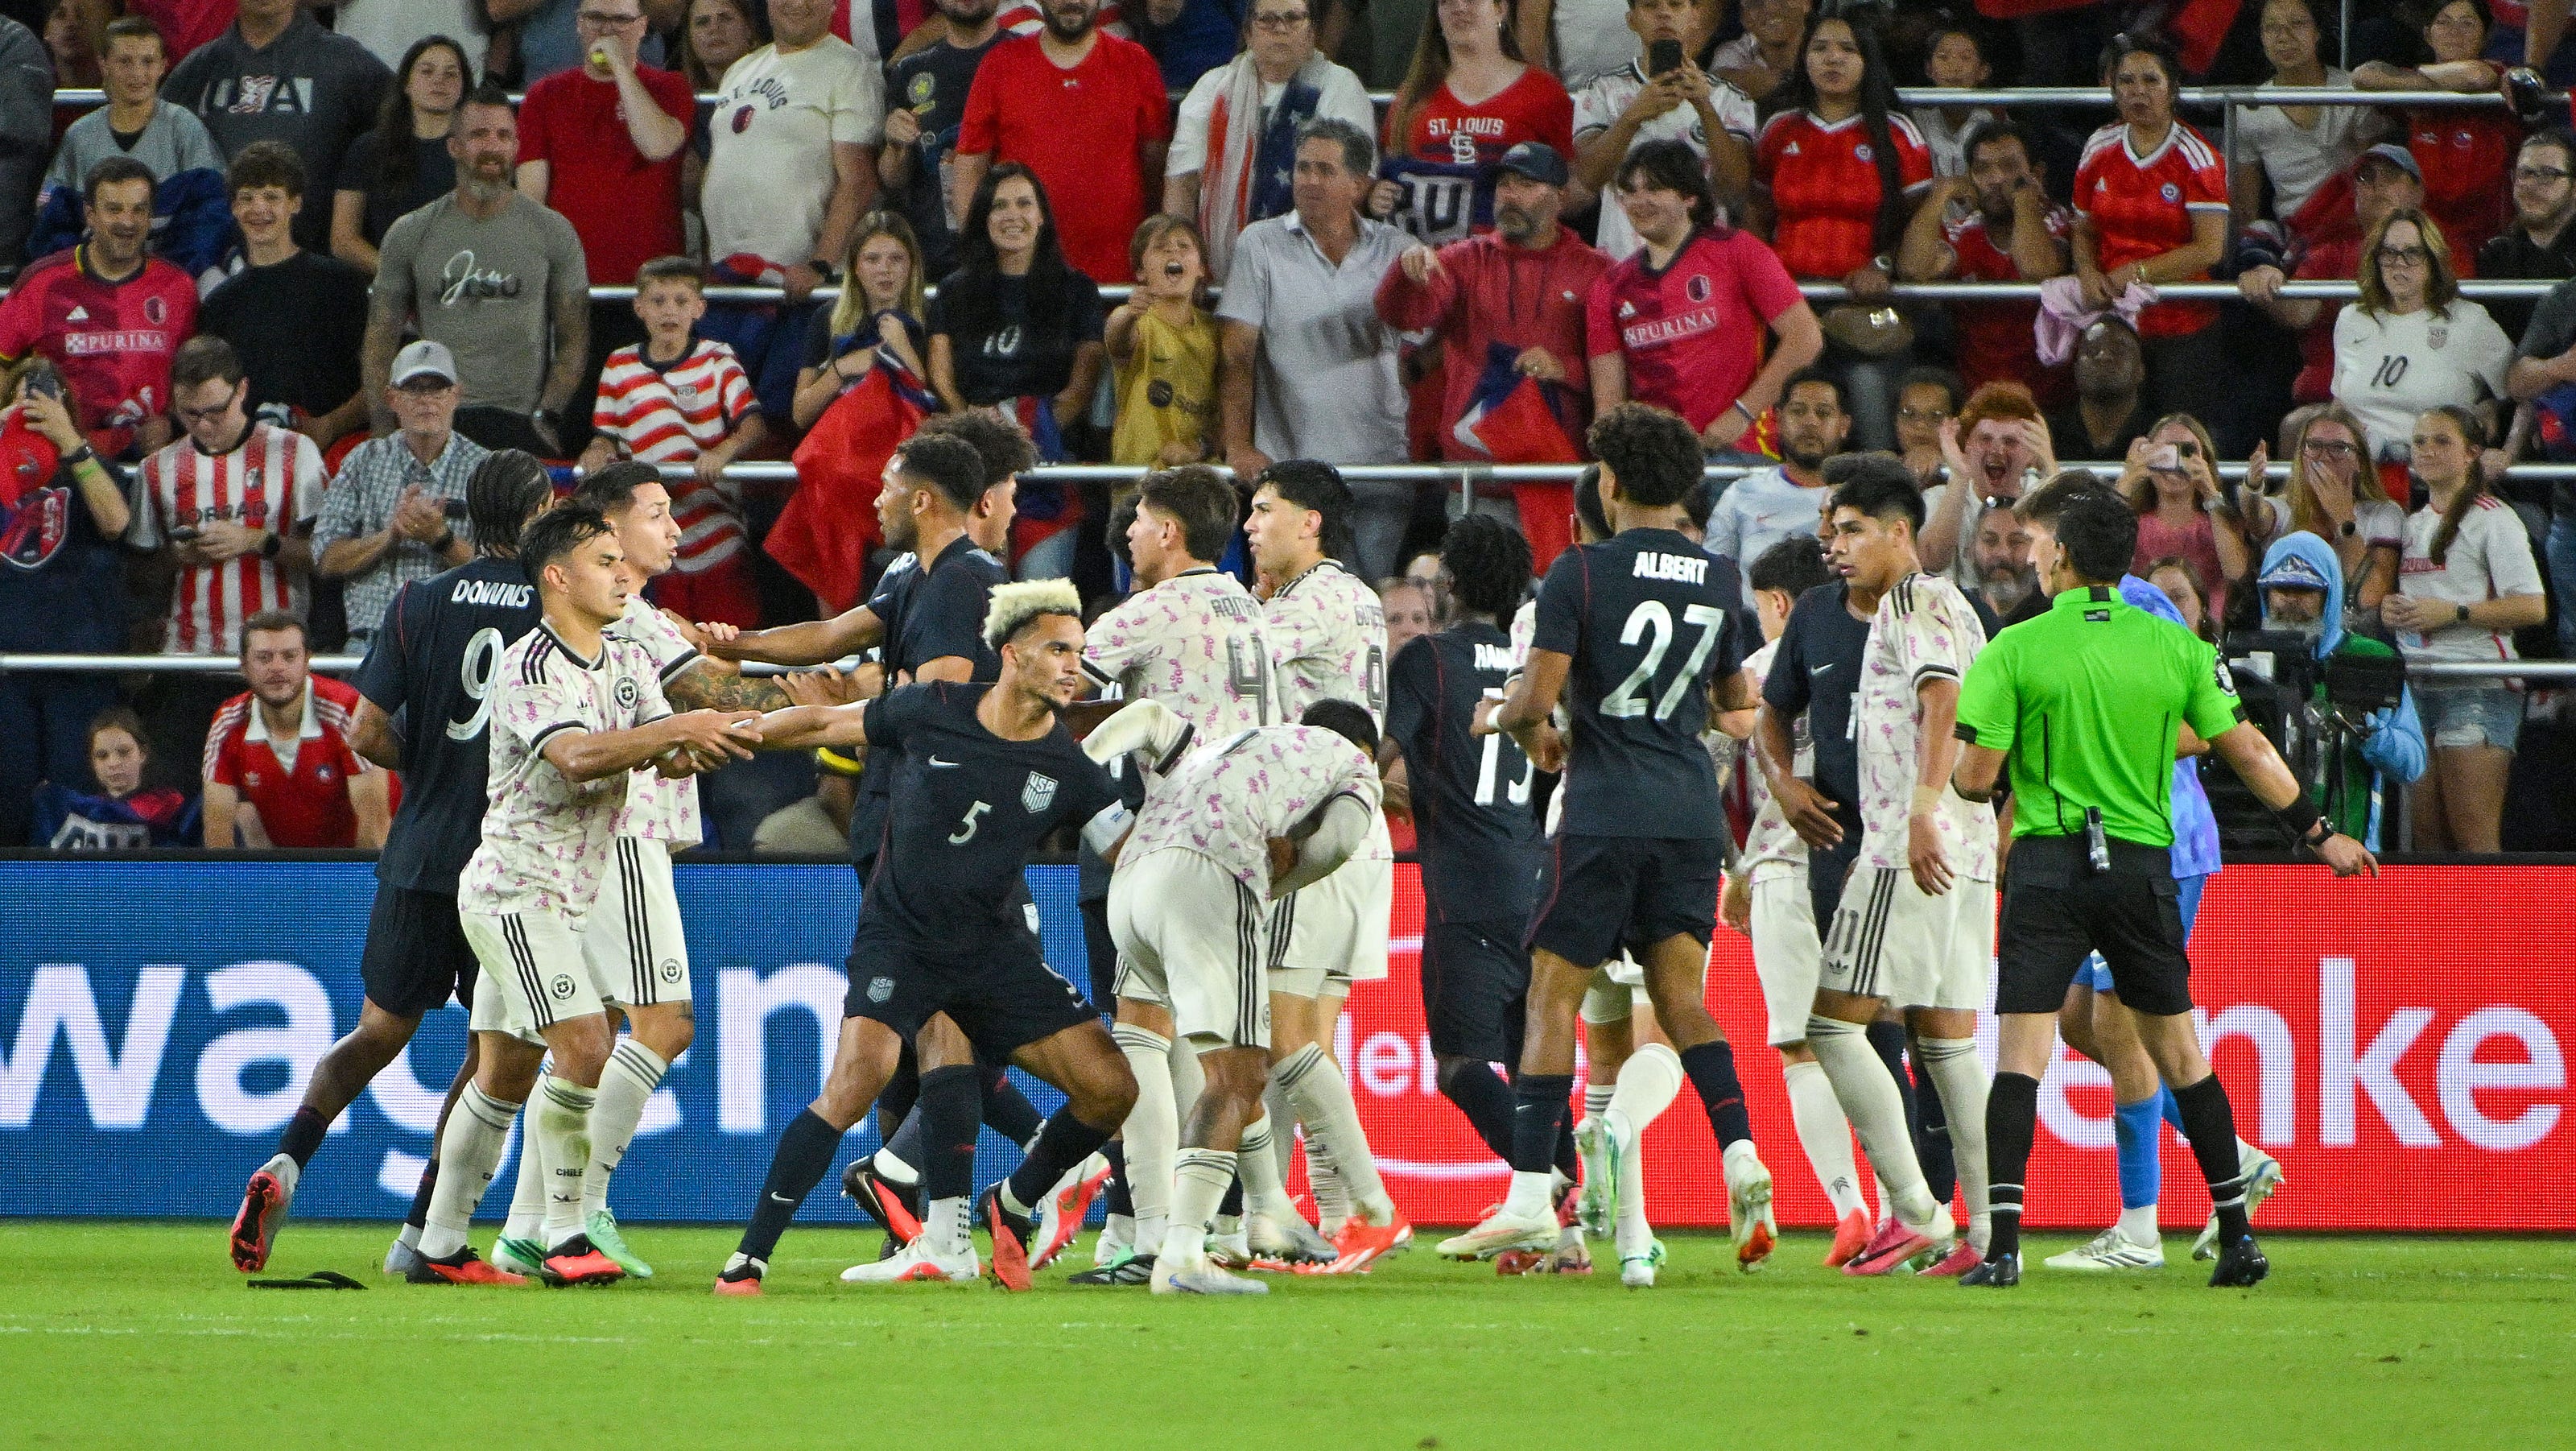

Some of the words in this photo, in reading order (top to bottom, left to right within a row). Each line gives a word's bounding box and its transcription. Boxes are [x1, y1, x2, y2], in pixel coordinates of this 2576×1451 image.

[749, 77, 788, 110] LOUIS
[1429, 118, 1451, 136] ST.
[88, 331, 164, 349] PURINA
[1637, 311, 1715, 343] PURINA
[2370, 354, 2409, 387] 10
[1633, 551, 1709, 585] ALBERT
[451, 579, 535, 607] DOWNS
[1600, 600, 1725, 721] 27
[445, 626, 505, 741] 9
[1225, 631, 1268, 726] 4
[1028, 773, 1056, 793] USA
[947, 800, 993, 844] 5
[1829, 907, 1860, 955] 11
[555, 1168, 584, 1178] CHILE
